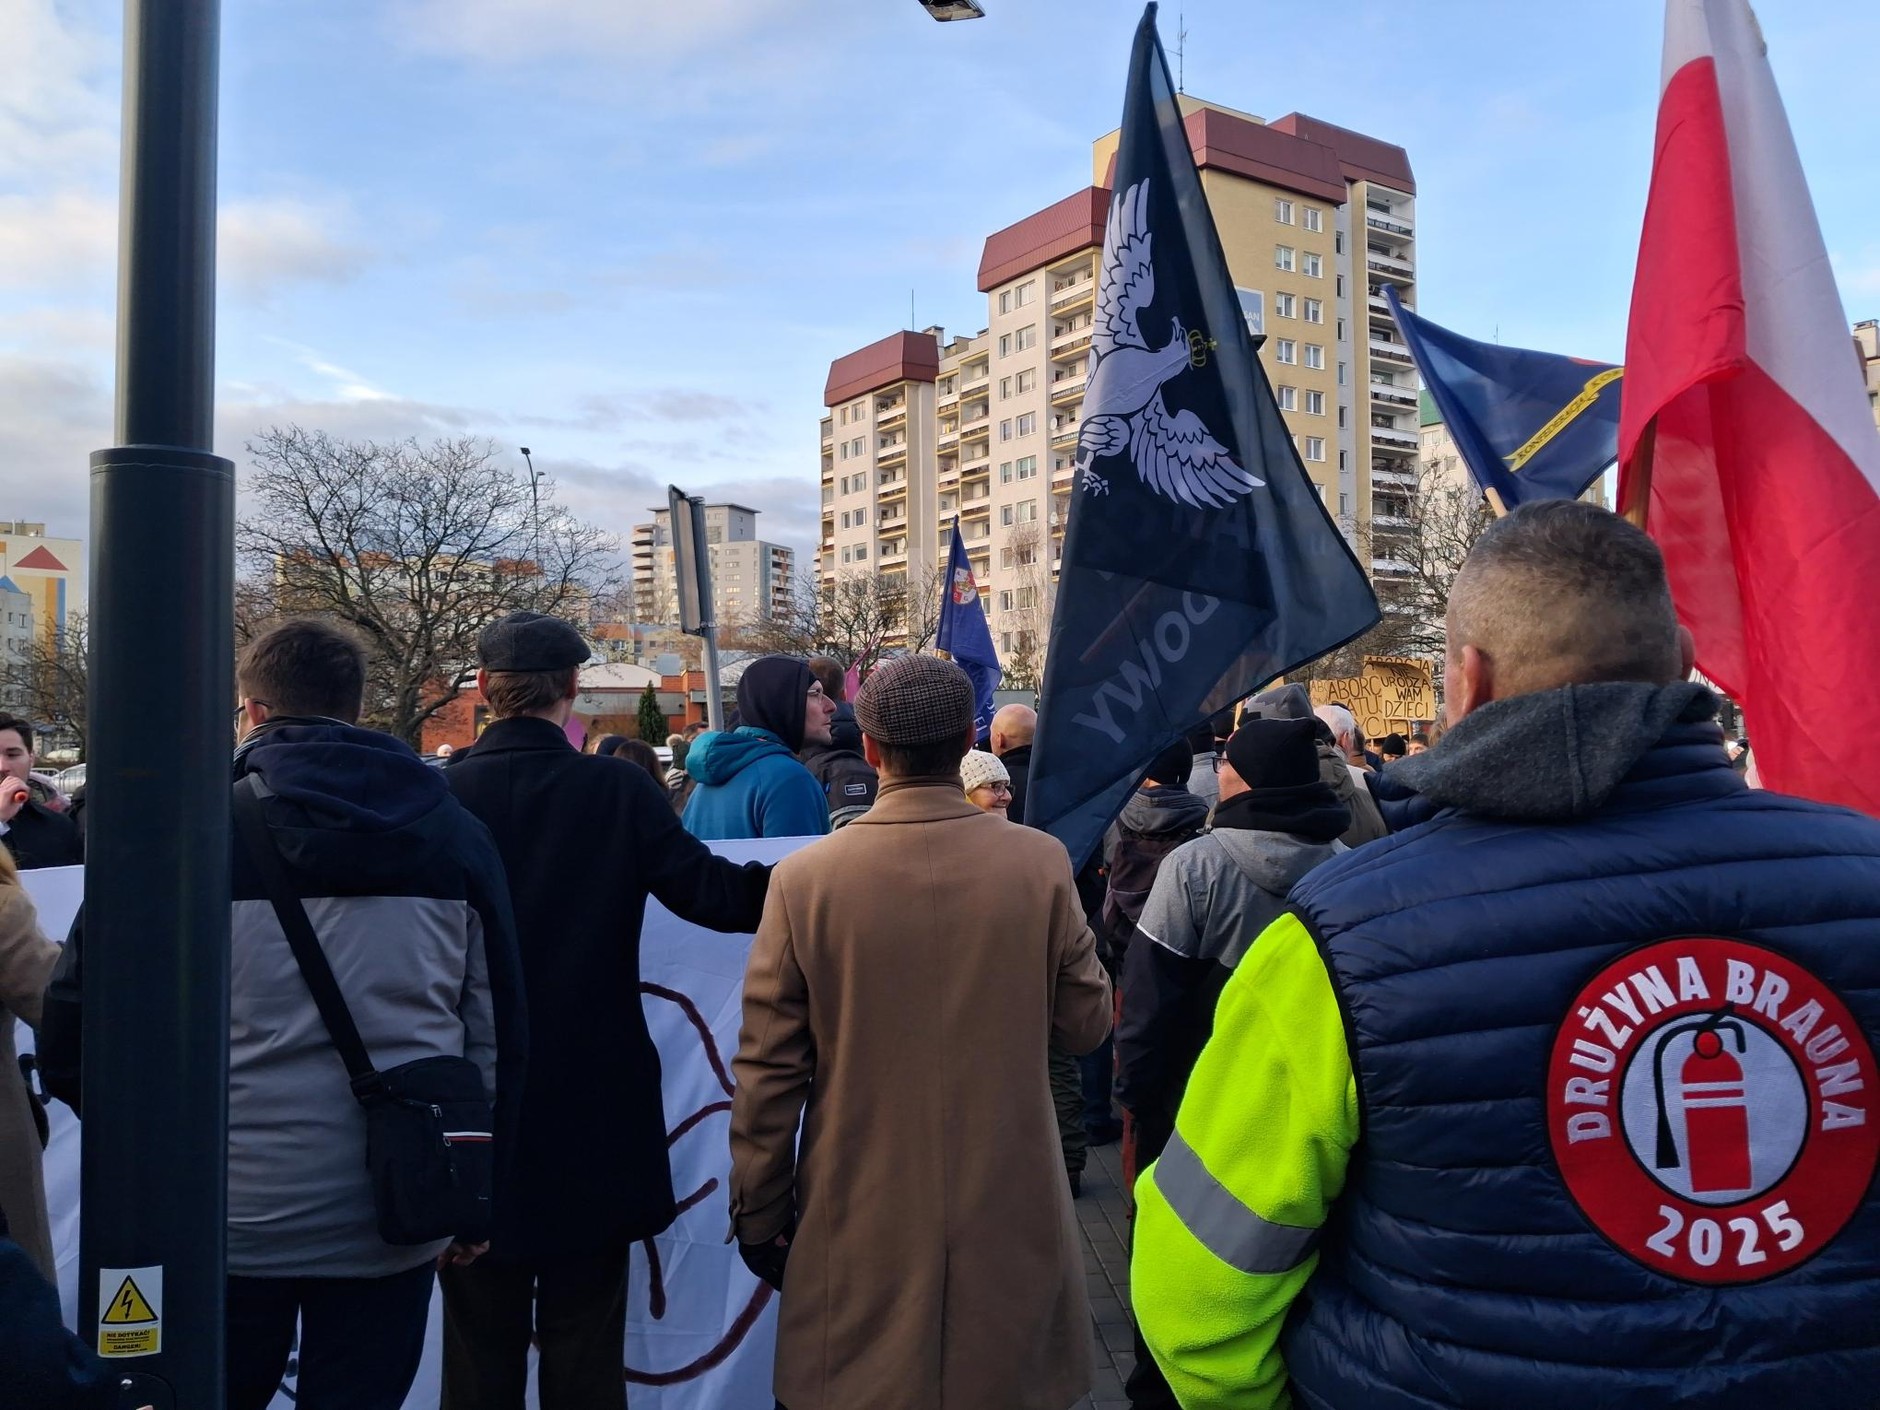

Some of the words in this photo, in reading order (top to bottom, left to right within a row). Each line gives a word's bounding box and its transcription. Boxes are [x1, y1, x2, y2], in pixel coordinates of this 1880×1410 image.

[1381, 676, 1431, 691] URODZĄ
[1396, 688, 1422, 701] WAM
[1385, 700, 1429, 718] DZIECI
[1565, 956, 1710, 1144] DRUŻYNA
[1725, 958, 1866, 1131] BRAUNA
[1646, 1200, 1804, 1266] 2025
